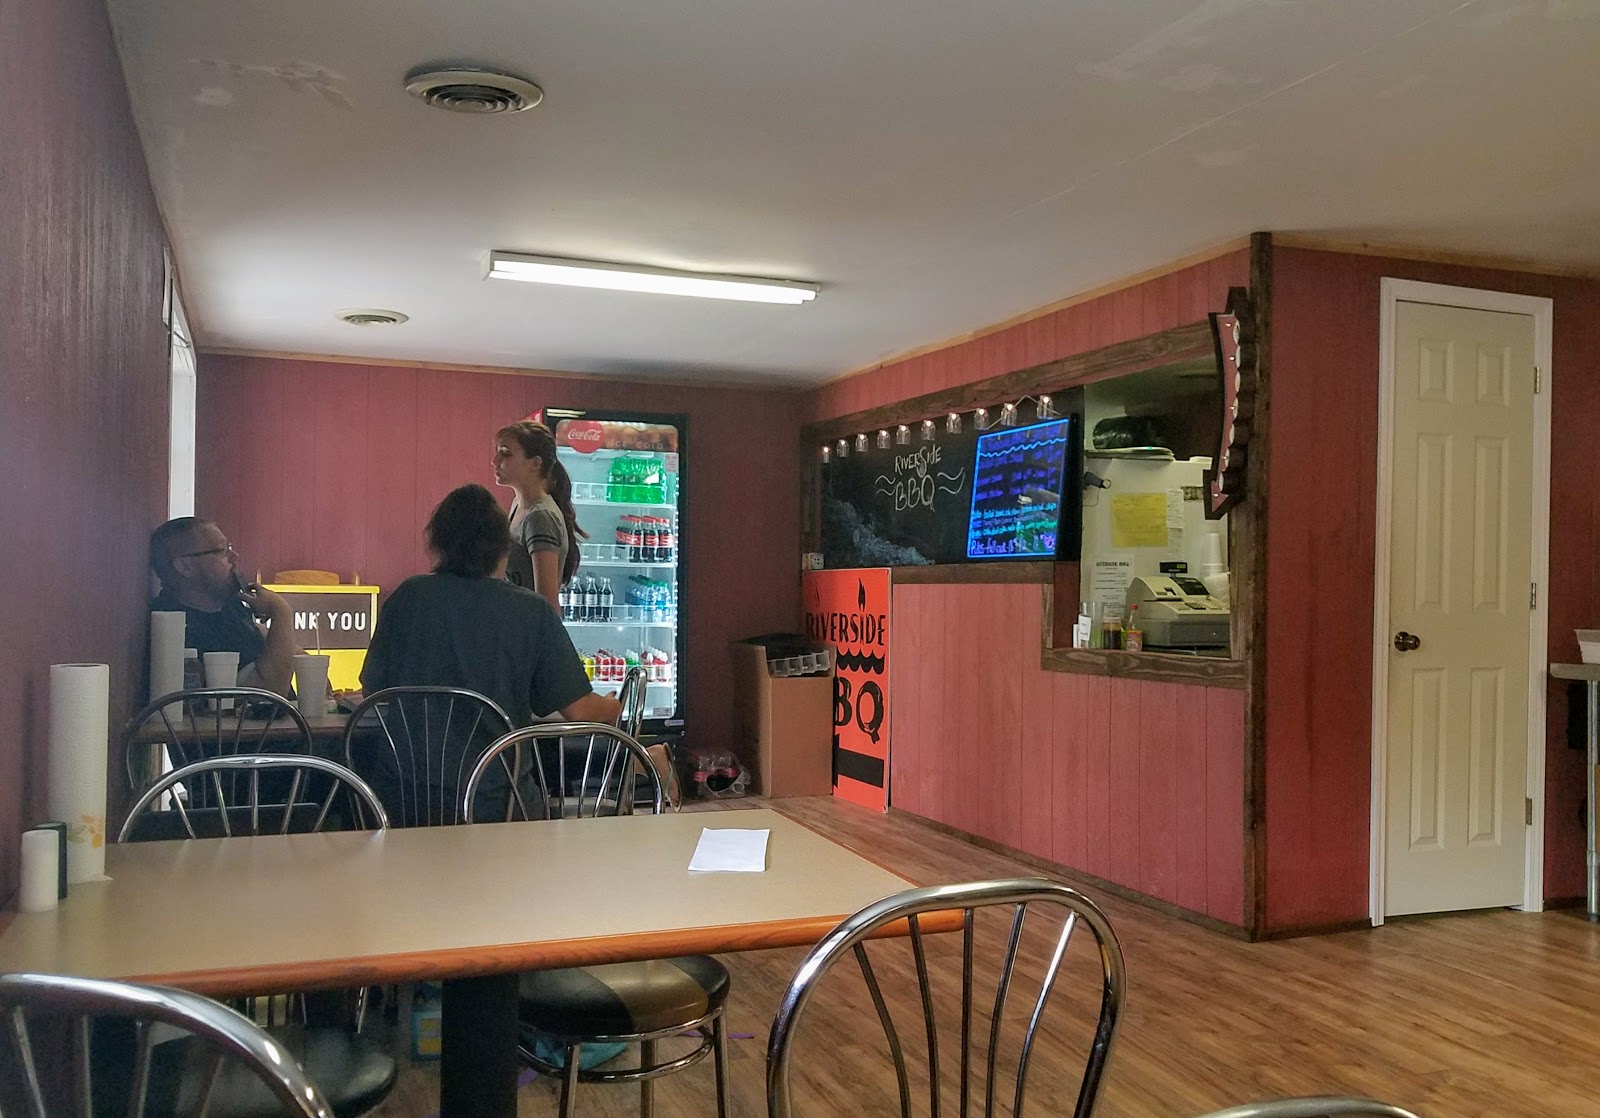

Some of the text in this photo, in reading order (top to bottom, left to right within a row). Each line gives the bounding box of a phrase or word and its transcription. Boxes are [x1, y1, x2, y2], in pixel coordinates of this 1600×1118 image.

[895, 474, 936, 512] BBQ
[327, 611, 366, 631] YOU
[805, 612, 886, 646] RIVERSIDE
